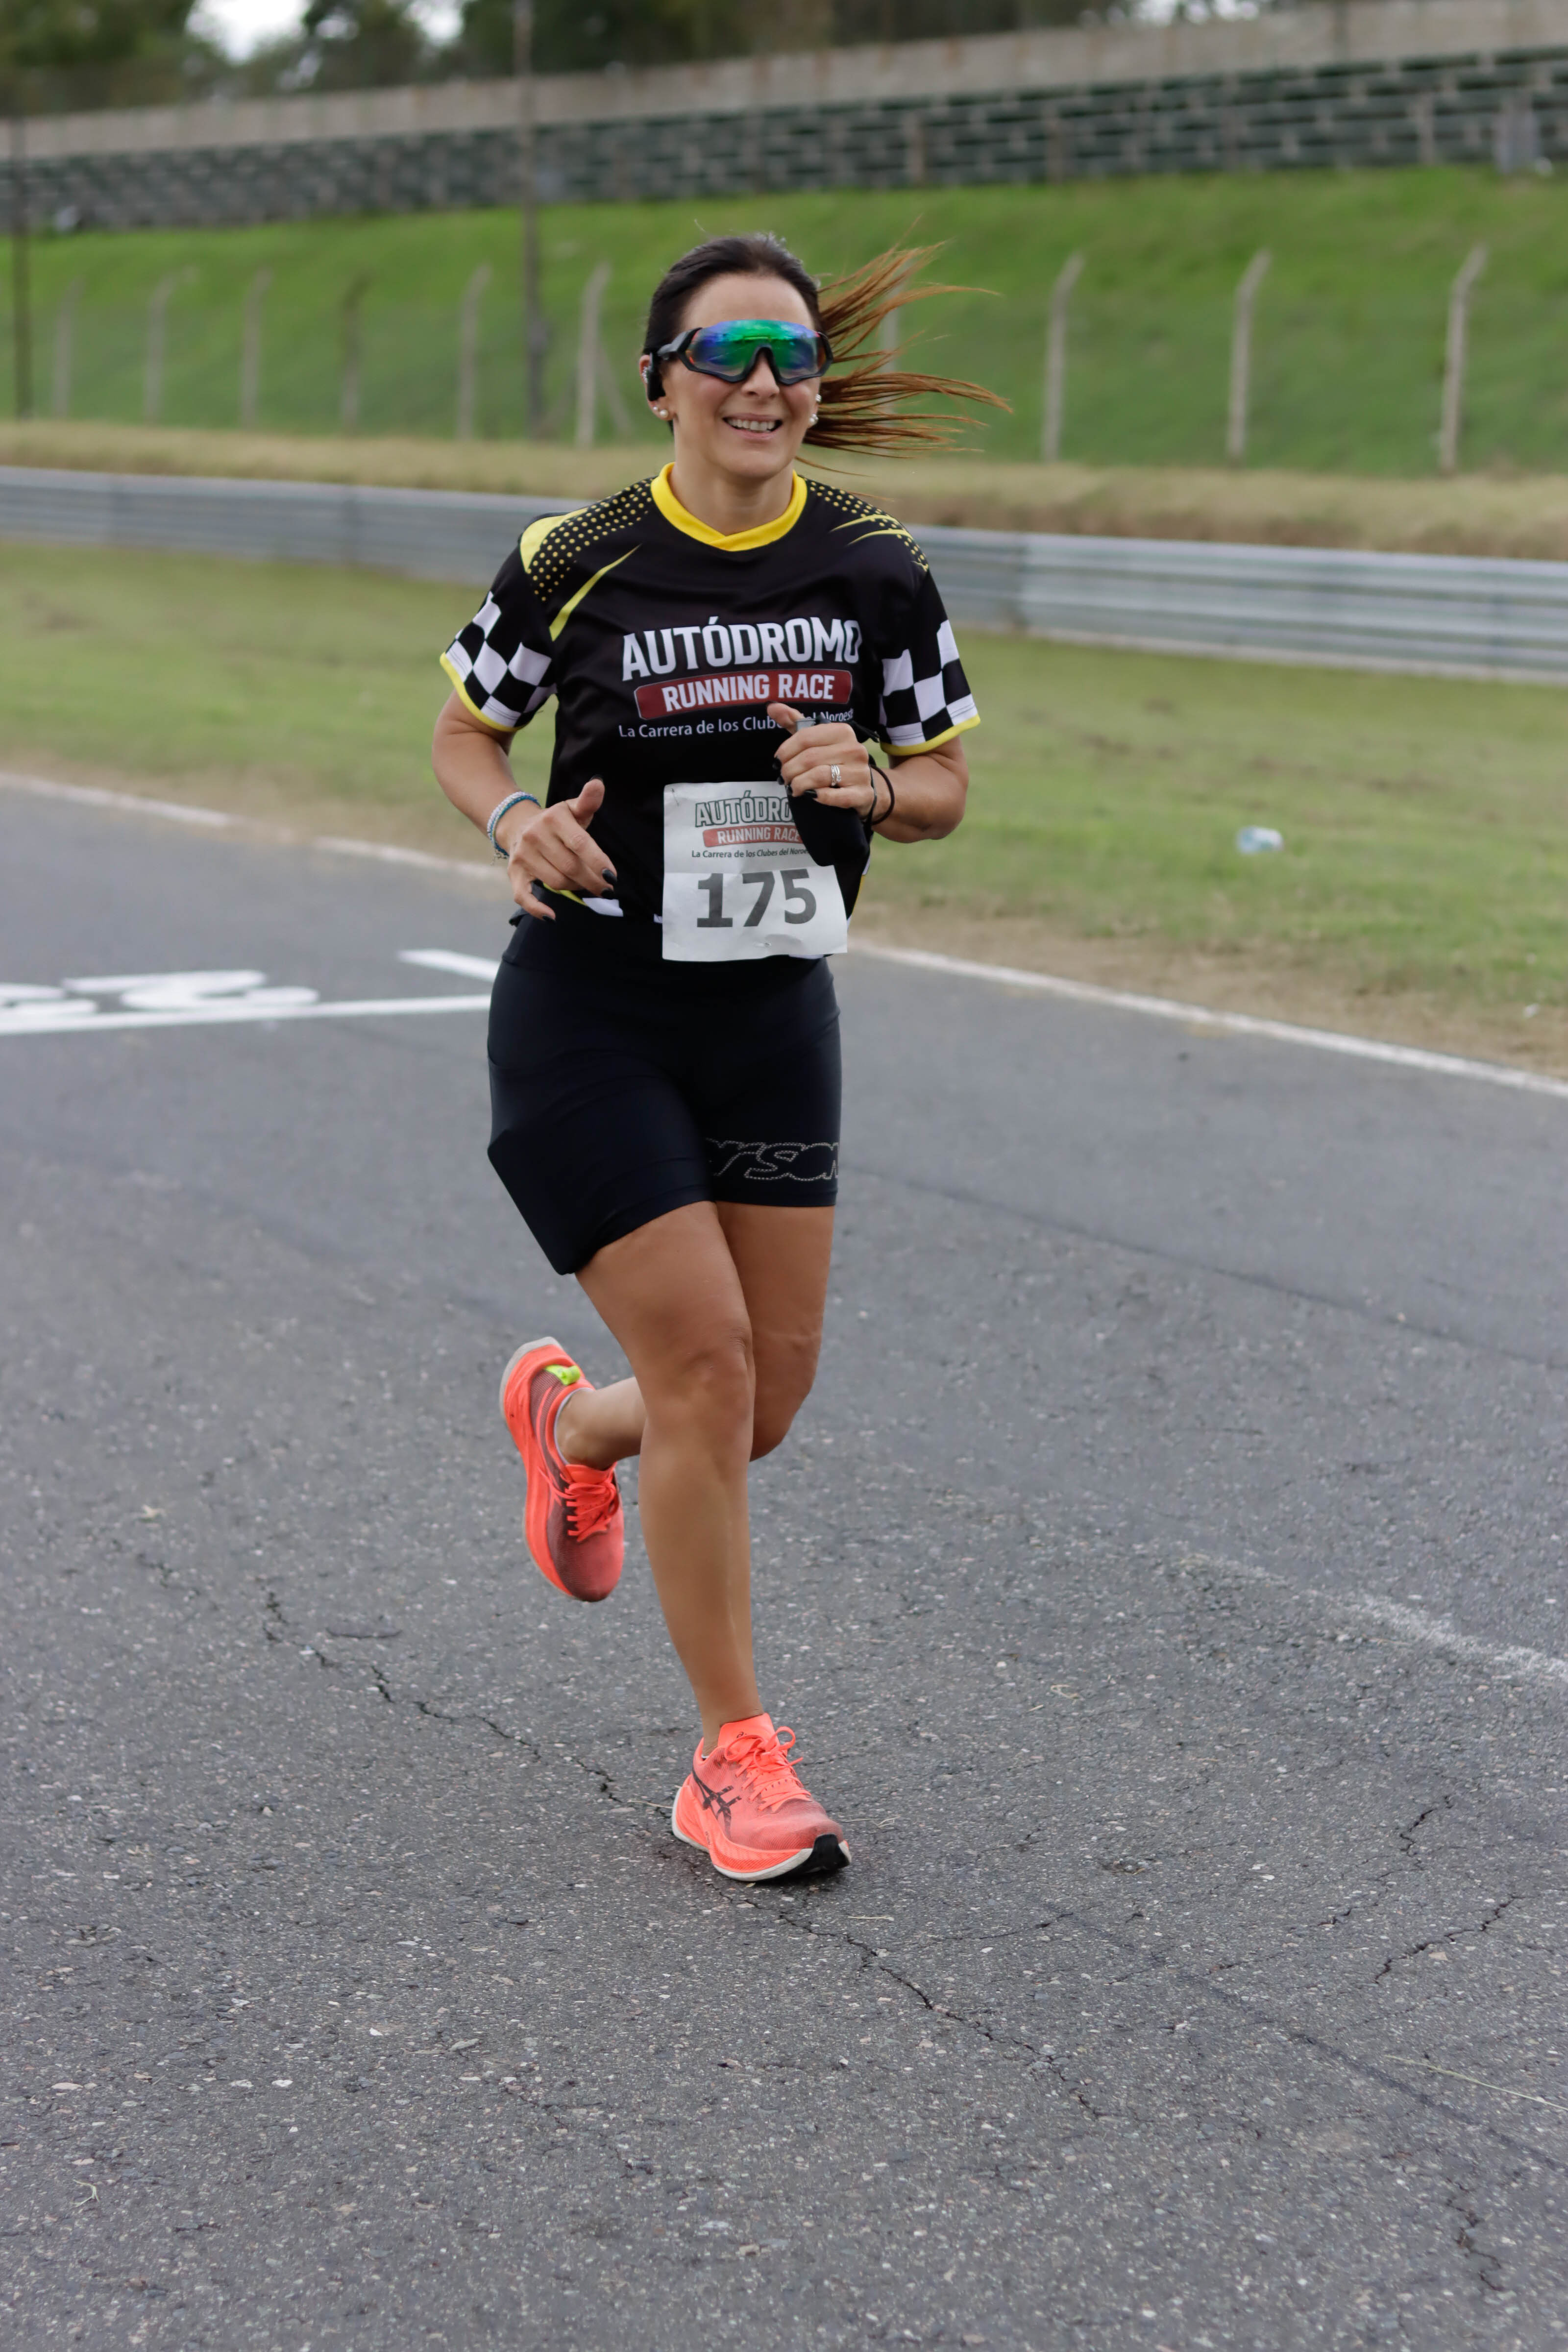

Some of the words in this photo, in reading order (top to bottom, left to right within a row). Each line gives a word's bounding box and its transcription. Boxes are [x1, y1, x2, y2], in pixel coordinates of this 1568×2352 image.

[622, 616, 862, 681] AUTÓDROMO
[662, 674, 770, 712] RUNNING
[778, 674, 835, 700] RACE
[619, 725, 635, 737] La
[638, 724, 692, 737] Carrera
[696, 720, 714, 734] de
[718, 718, 739, 732] los
[743, 715, 783, 731] Club
[820, 708, 854, 722] Noroest
[695, 790, 794, 828] AUTÓDRO
[717, 827, 771, 844] RUNNING
[774, 827, 800, 842] RACE
[757, 848, 778, 857] Clubes
[697, 868, 817, 928] 175
